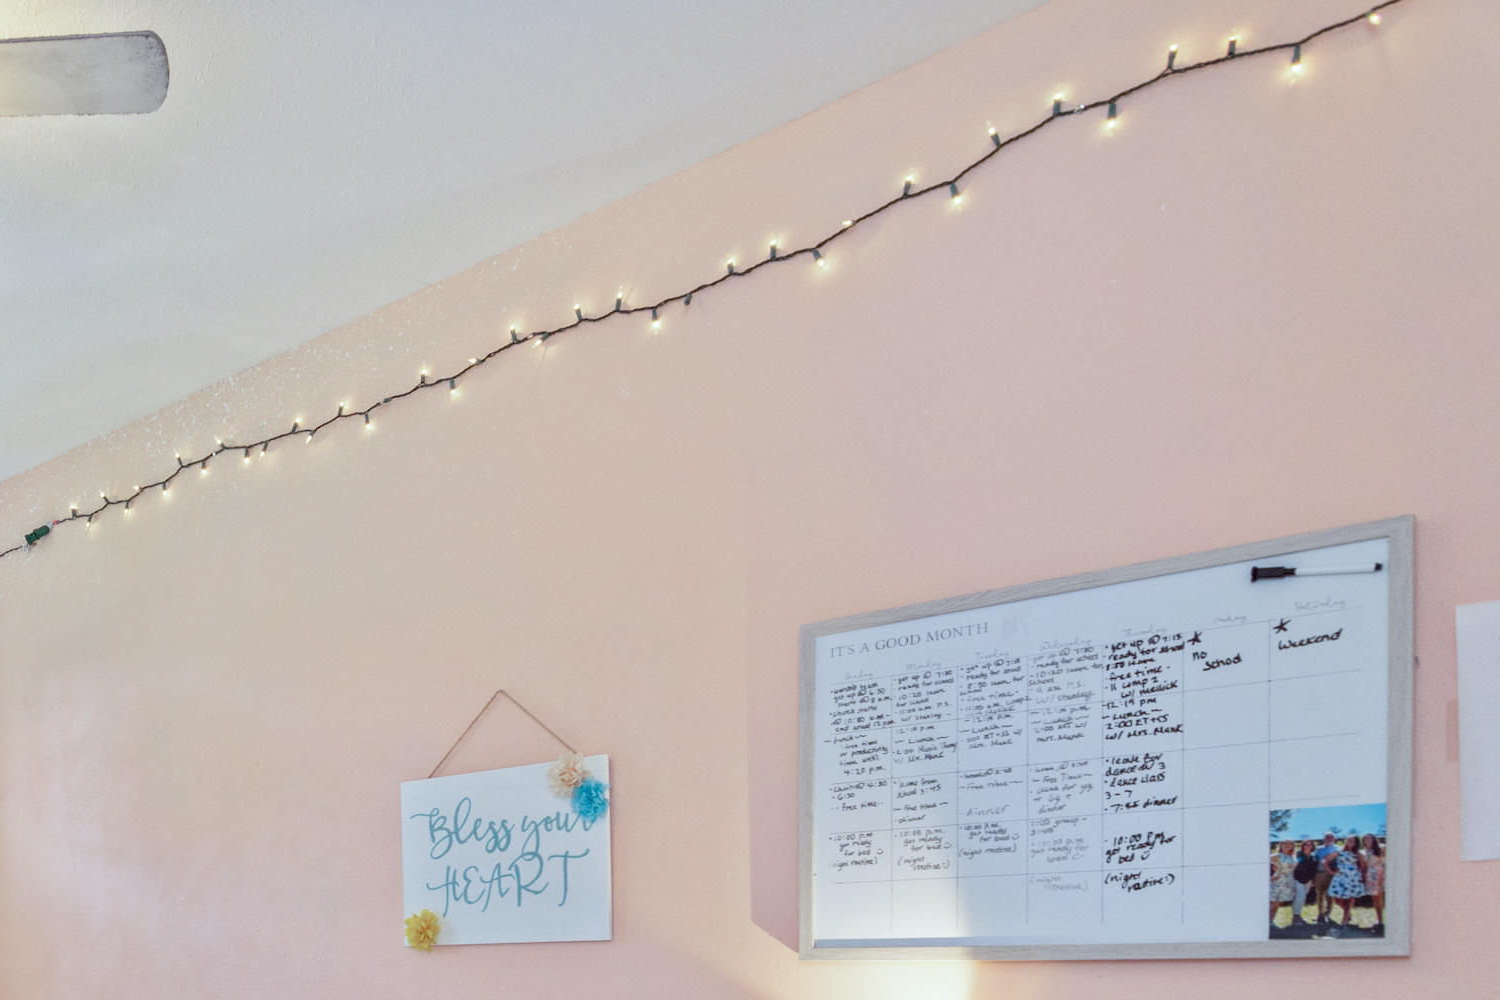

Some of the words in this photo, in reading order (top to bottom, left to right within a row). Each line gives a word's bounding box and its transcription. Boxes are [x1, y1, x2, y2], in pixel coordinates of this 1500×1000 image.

[860, 643, 870, 653] A
[875, 634, 921, 650] GOOD
[926, 622, 988, 642] MONTH
[1111, 642, 1127, 653] get
[1130, 640, 1143, 650] up
[1148, 634, 1160, 645] @
[1278, 628, 1343, 650] Weekend
[1108, 651, 1137, 661] ready
[1140, 647, 1157, 655] for
[1192, 651, 1207, 661] no
[1109, 672, 1131, 681] free
[1113, 710, 1150, 720] Lunch
[1105, 720, 1132, 729] 2:00
[1105, 731, 1124, 740] w/
[1105, 765, 1137, 777] dance
[1159, 762, 1166, 770] 3
[1124, 790, 1133, 798] 7
[1142, 796, 1178, 808] dinner
[410, 797, 515, 860] Bless
[1113, 833, 1142, 846] 10:00
[1105, 848, 1120, 863] get
[1118, 853, 1135, 864] bed
[426, 848, 590, 918] HEART
